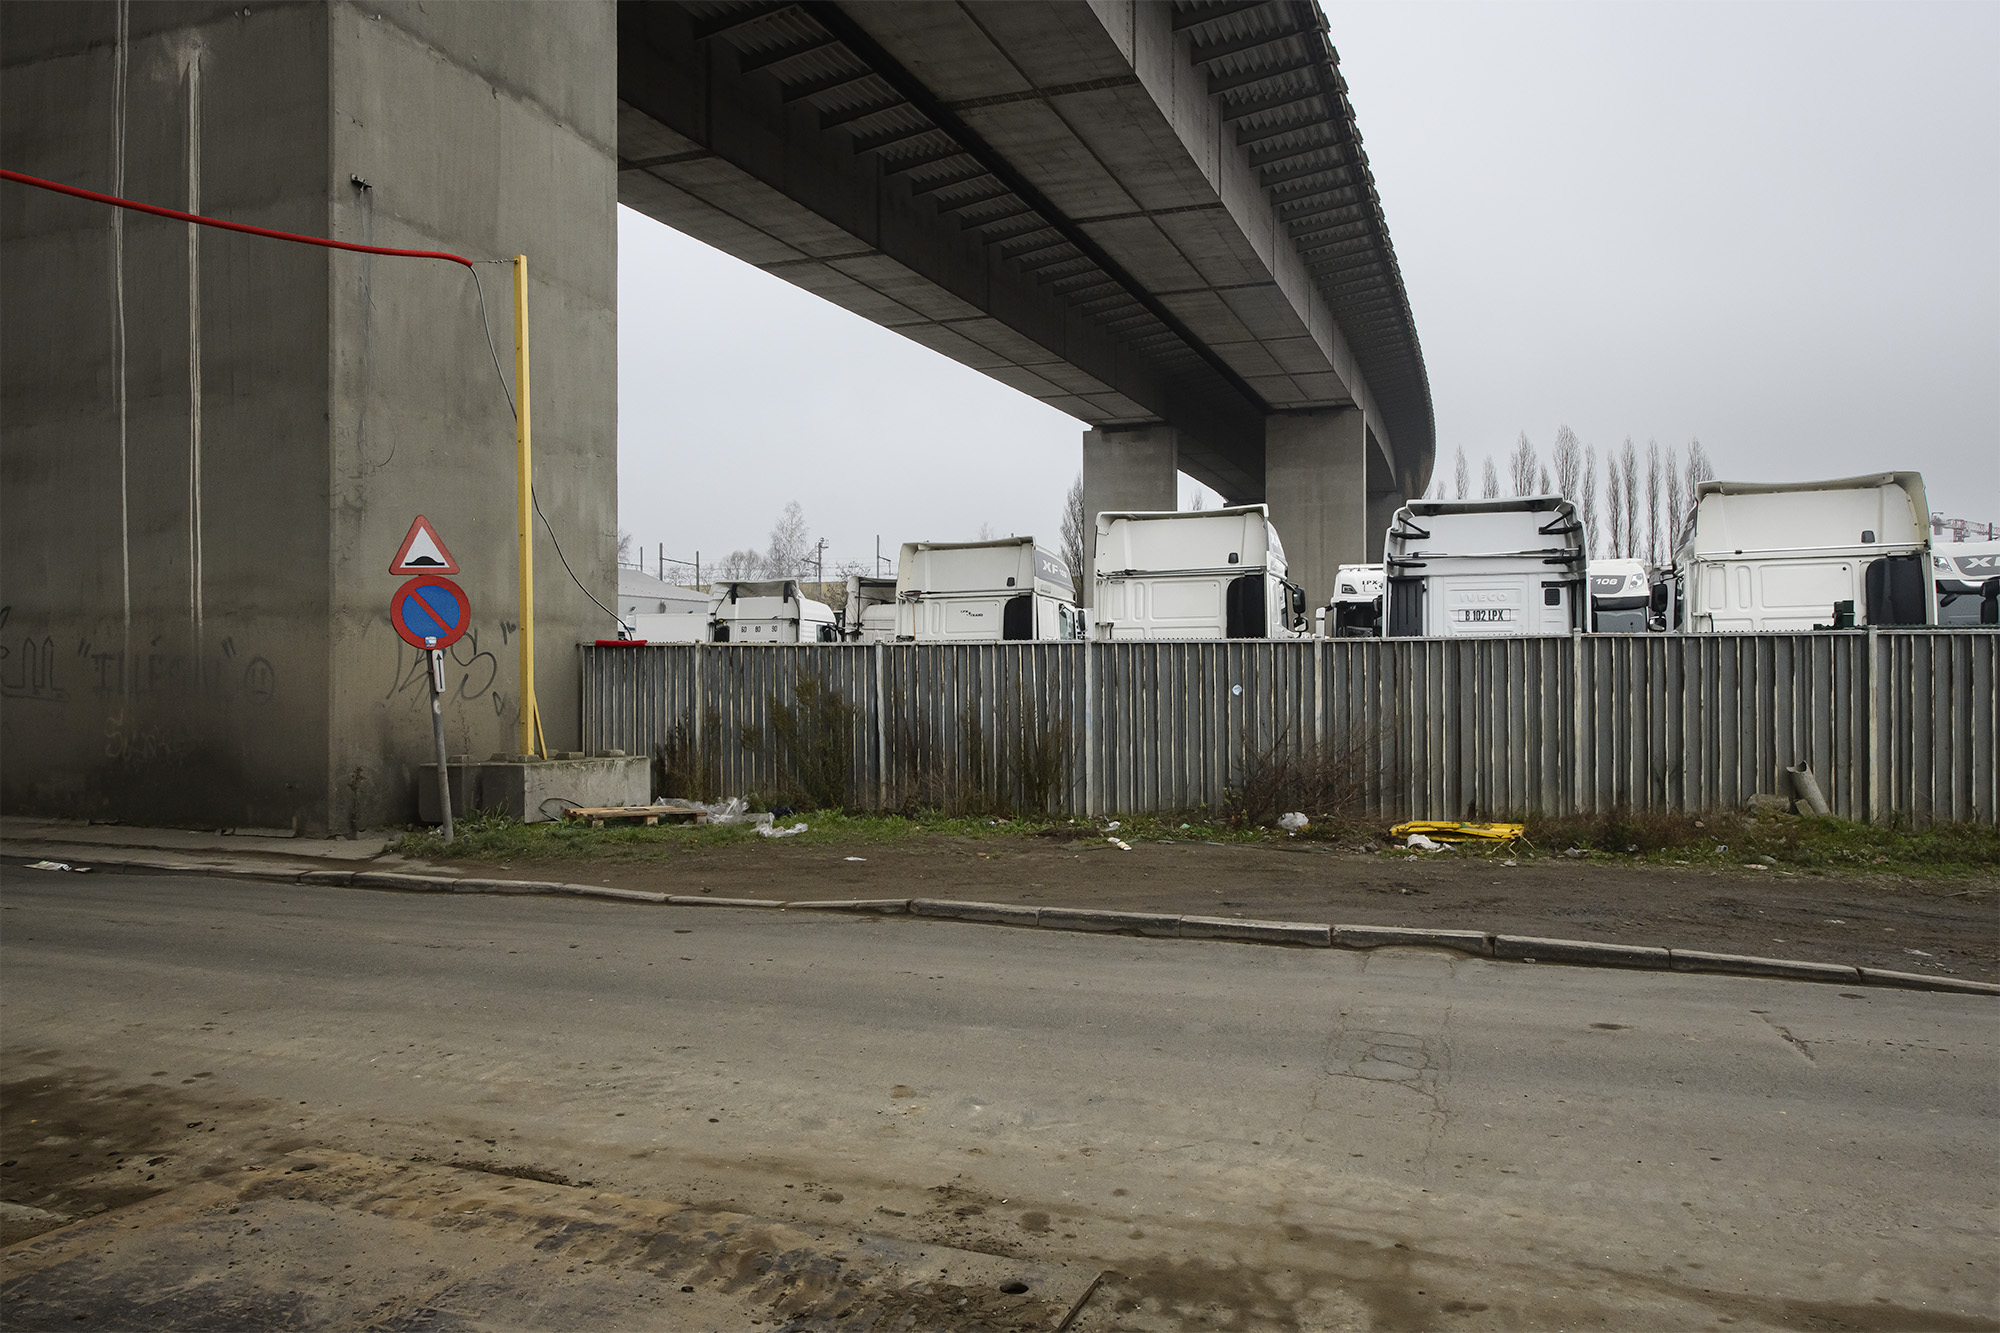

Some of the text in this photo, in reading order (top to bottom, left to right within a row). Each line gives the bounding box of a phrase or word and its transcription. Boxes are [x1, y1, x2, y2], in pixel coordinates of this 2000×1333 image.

[1042, 559, 1058, 574] XF
[1965, 557, 2000, 569] X
[1460, 593, 1507, 603] IVECO
[1465, 610, 1504, 621] B 102 LPX
